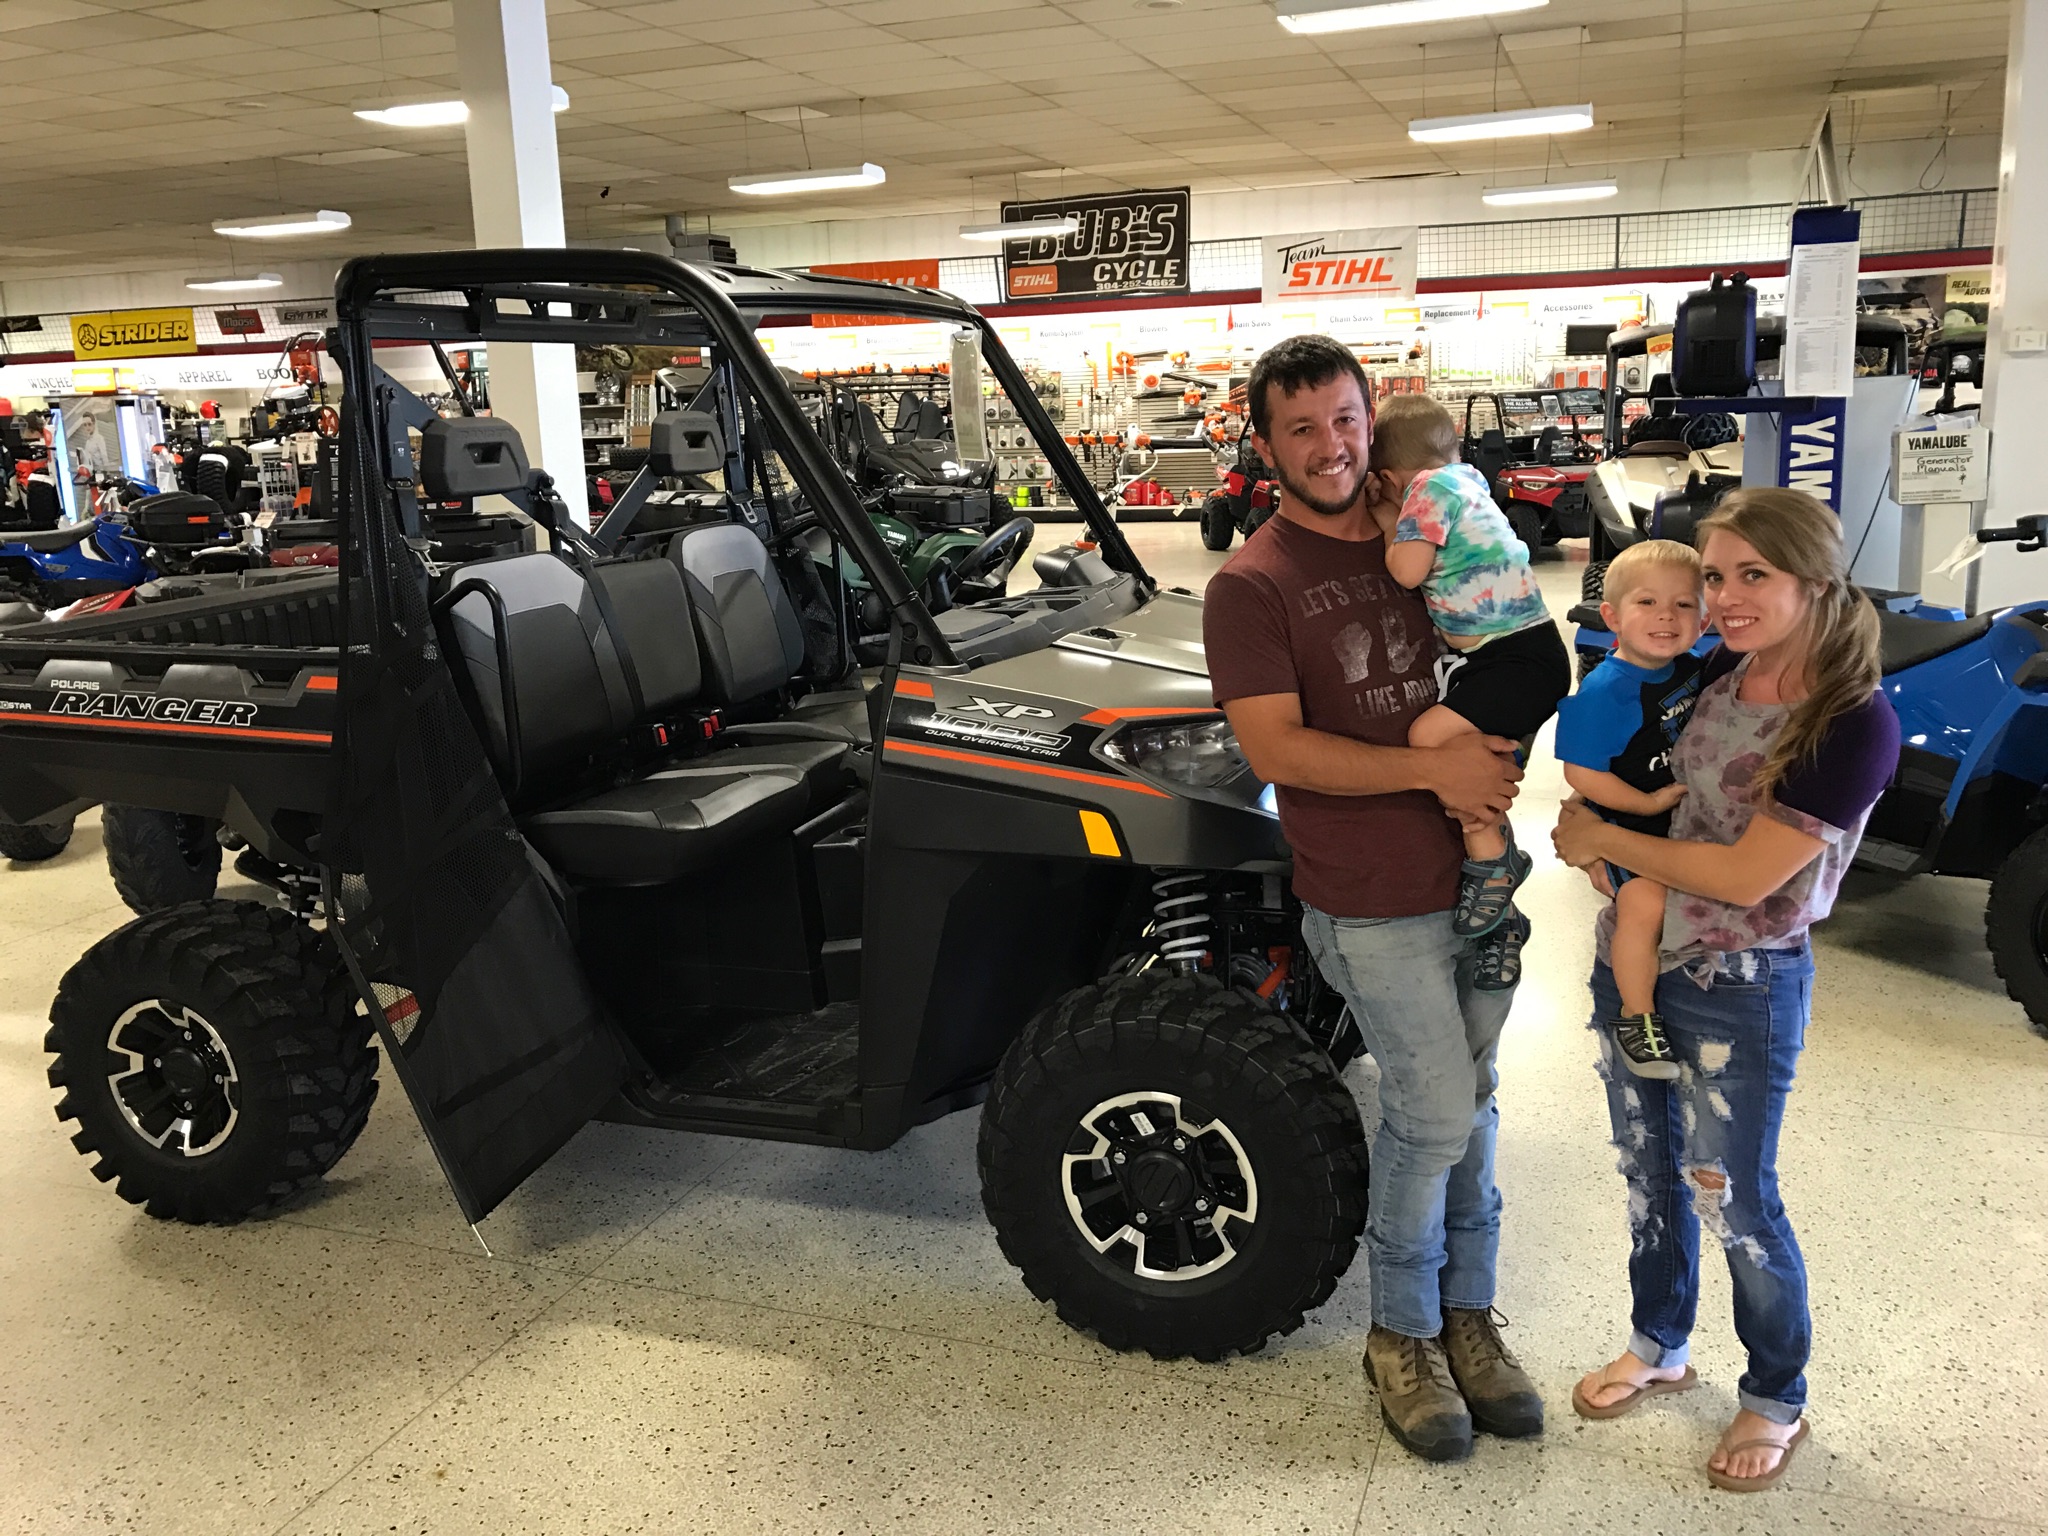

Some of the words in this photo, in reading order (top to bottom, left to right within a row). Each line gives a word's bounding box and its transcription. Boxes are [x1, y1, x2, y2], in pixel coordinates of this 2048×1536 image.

[1277, 237, 1326, 274] Team
[1093, 259, 1180, 282] CYCLE
[1288, 257, 1393, 287] STIHL
[1013, 273, 1053, 287] STIHL
[1096, 278, 1176, 291] 304-252-4662
[1951, 280, 1970, 289] REAL
[1424, 310, 1471, 319] Replacement
[1543, 304, 1593, 312] Accessories
[223, 317, 255, 328] Moose
[1329, 315, 1351, 323] Chain
[99, 320, 189, 346] STRIDER
[28, 375, 74, 389] WINCHE
[178, 369, 232, 384] APPAREL
[1908, 434, 1967, 450] YAMALUBE
[1916, 455, 1974, 465] Generator
[1916, 463, 1967, 473] Manuals
[1299, 579, 1350, 619] LET'S
[50, 679, 100, 691] POLARIS
[0, 701, 32, 710] OSTAR
[49, 691, 258, 727] RANGER
[946, 695, 1056, 719] XP
[1354, 684, 1401, 720] LIKE
[930, 712, 1072, 751] 1000
[925, 728, 958, 740] DUAL
[961, 735, 1029, 752] OVERHEAD
[1031, 748, 1061, 757] CAM
